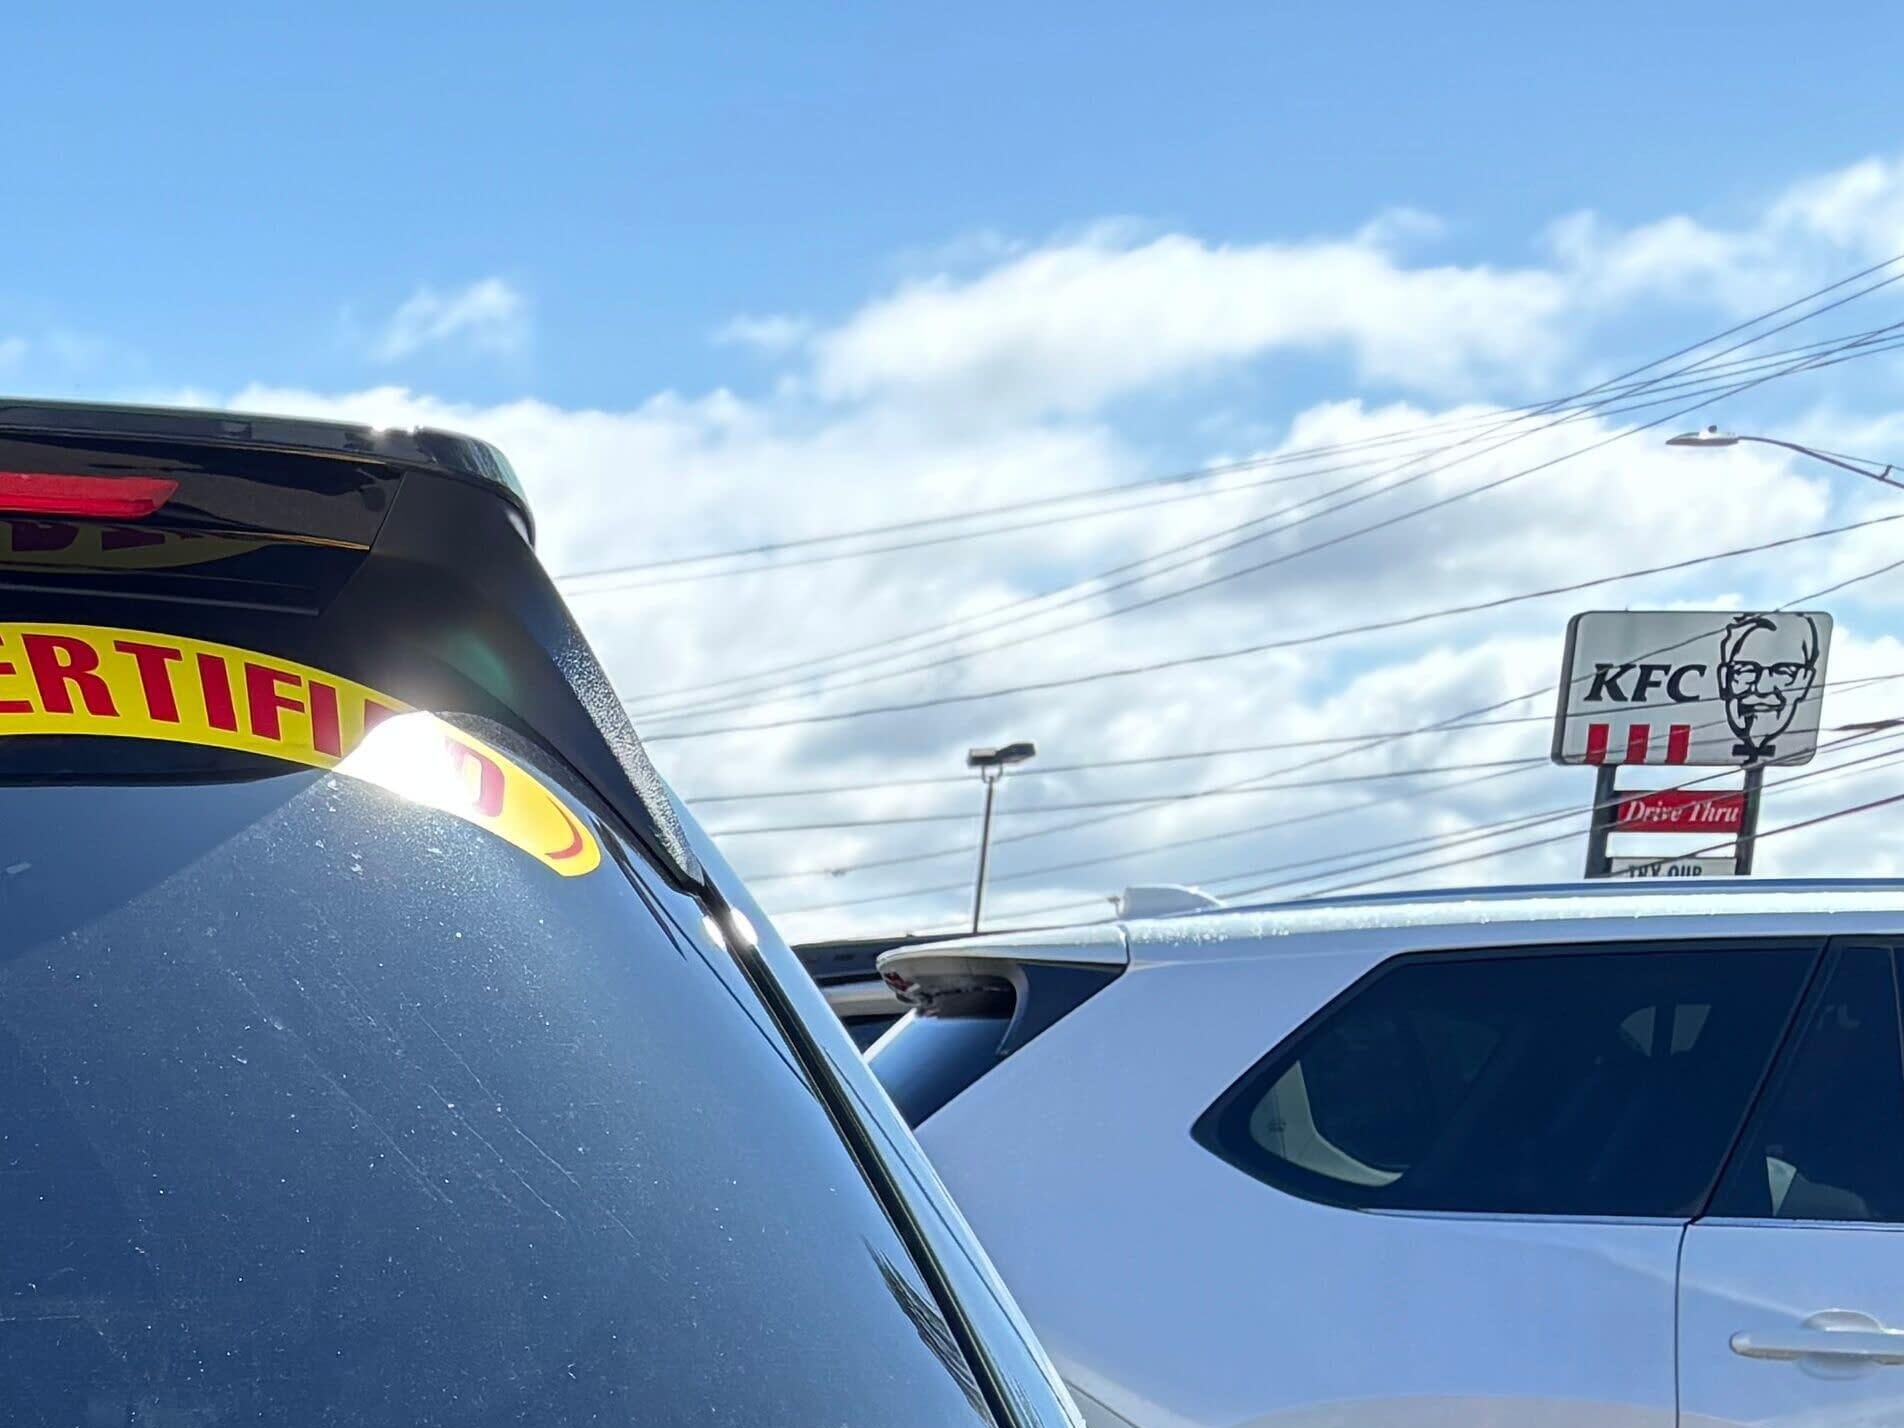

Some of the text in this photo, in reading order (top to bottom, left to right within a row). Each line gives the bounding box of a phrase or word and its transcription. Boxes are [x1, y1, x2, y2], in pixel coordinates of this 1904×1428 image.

[1583, 663, 1707, 703] KFC
[1625, 800, 1740, 822] Drive Thru
